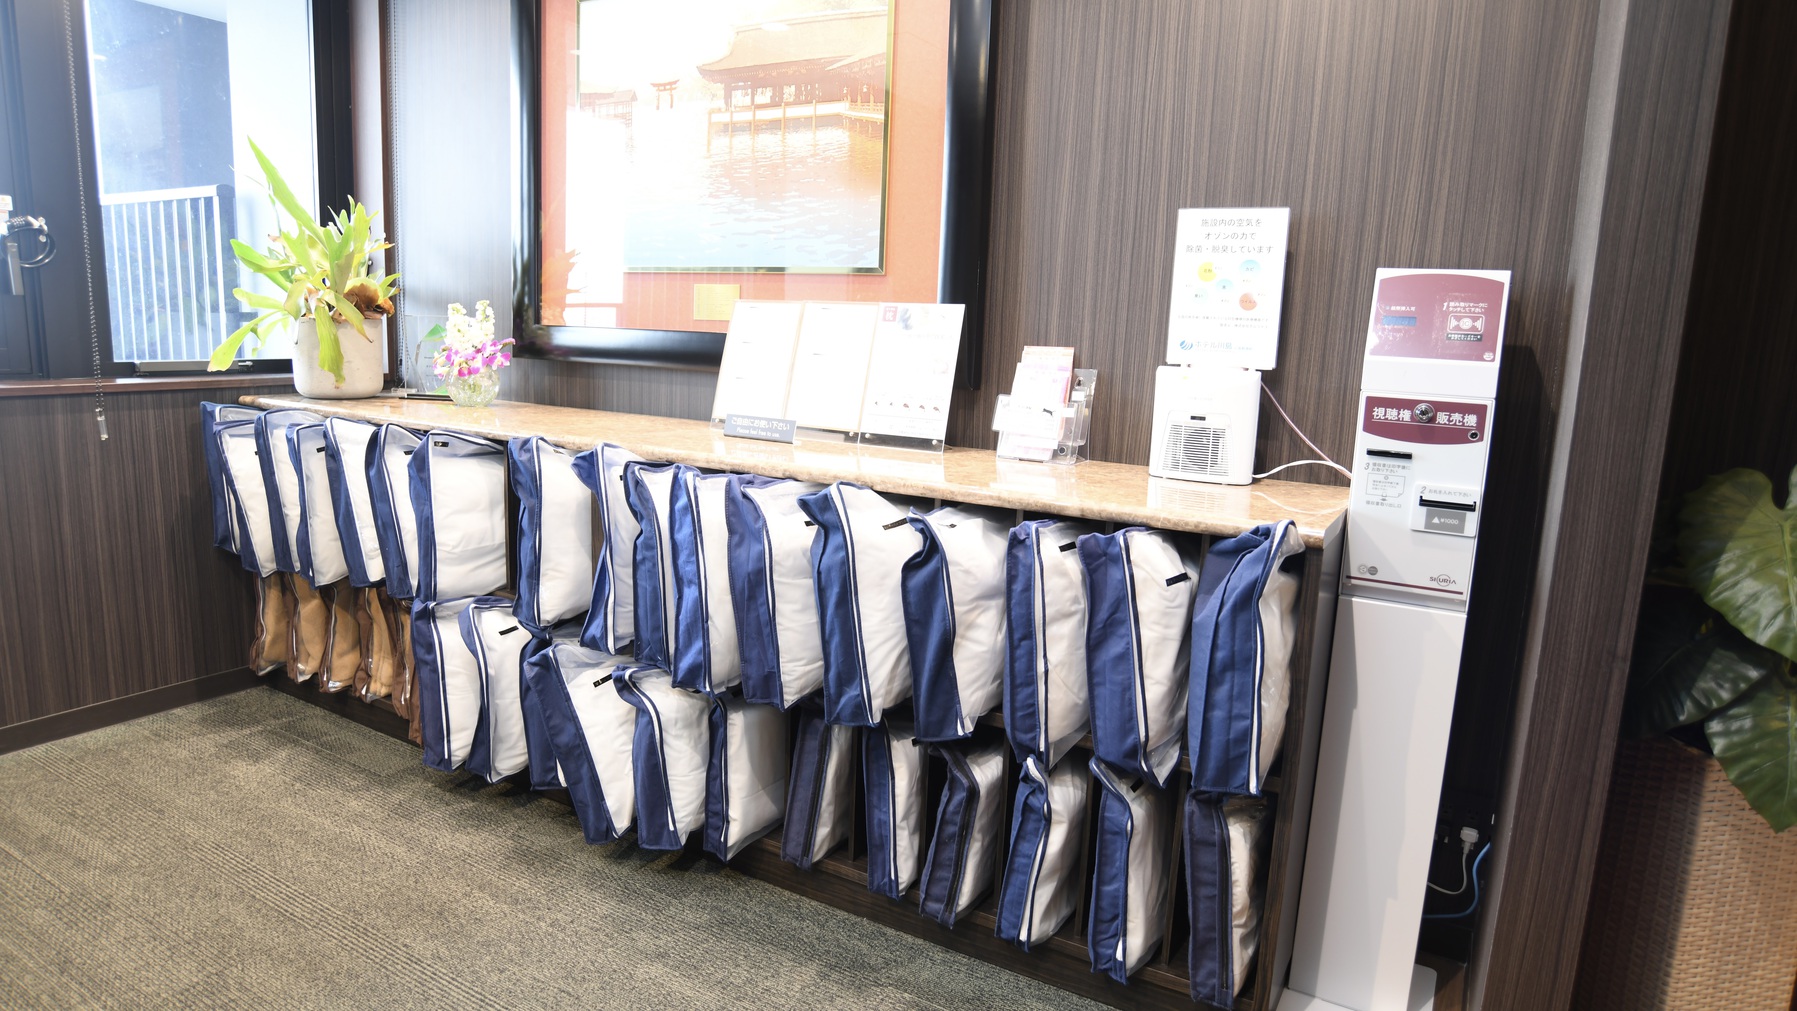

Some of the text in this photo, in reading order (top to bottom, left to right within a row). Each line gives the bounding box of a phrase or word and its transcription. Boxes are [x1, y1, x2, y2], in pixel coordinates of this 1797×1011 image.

[1201, 218, 1262, 228] 施設内の空気を
[1186, 244, 1274, 254] 除菌・脱臭しています
[1443, 301, 1448, 311] 1
[1372, 406, 1478, 427] 視聴権 販売機
[731, 417, 790, 430] ご自由にお使い下さい
[1364, 462, 1370, 471] 3
[1420, 485, 1472, 498] 2 お札を入れて下さい
